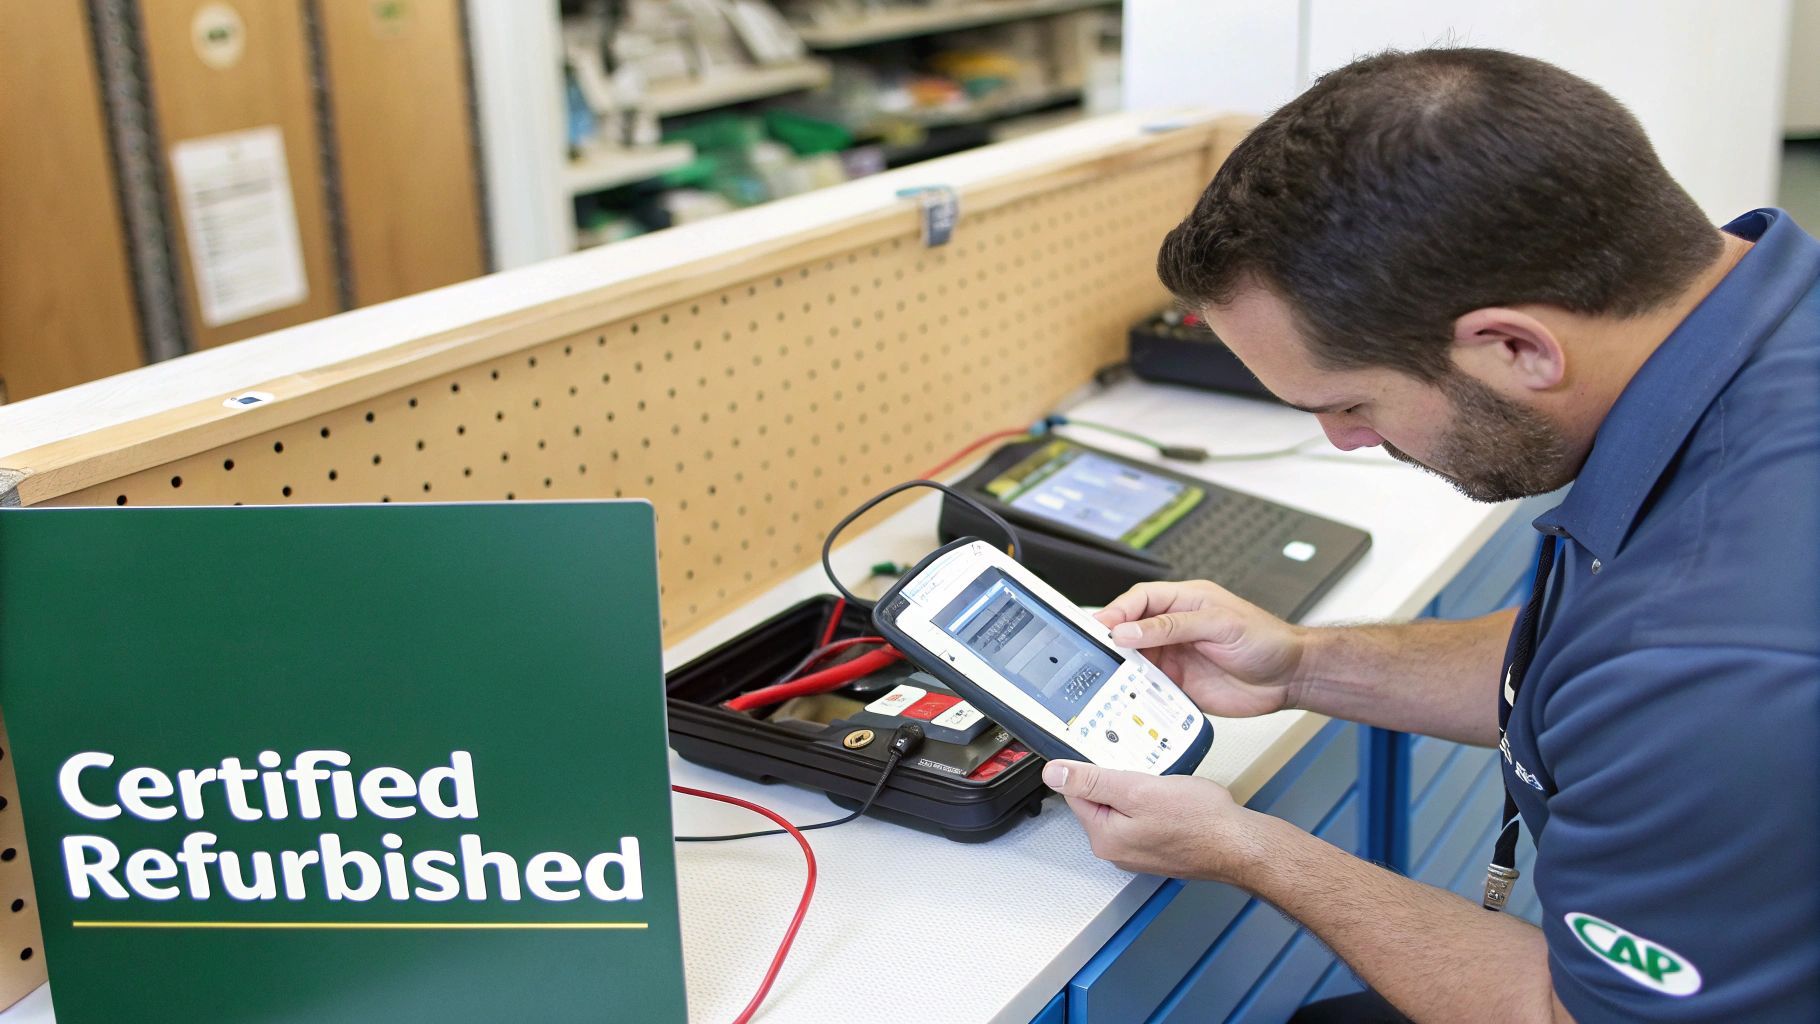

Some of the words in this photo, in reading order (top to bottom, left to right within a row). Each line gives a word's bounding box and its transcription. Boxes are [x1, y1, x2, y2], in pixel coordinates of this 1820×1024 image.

[59, 749, 478, 821] Certified
[62, 832, 643, 902] Refurbished
[1574, 918, 1682, 982] CAP
